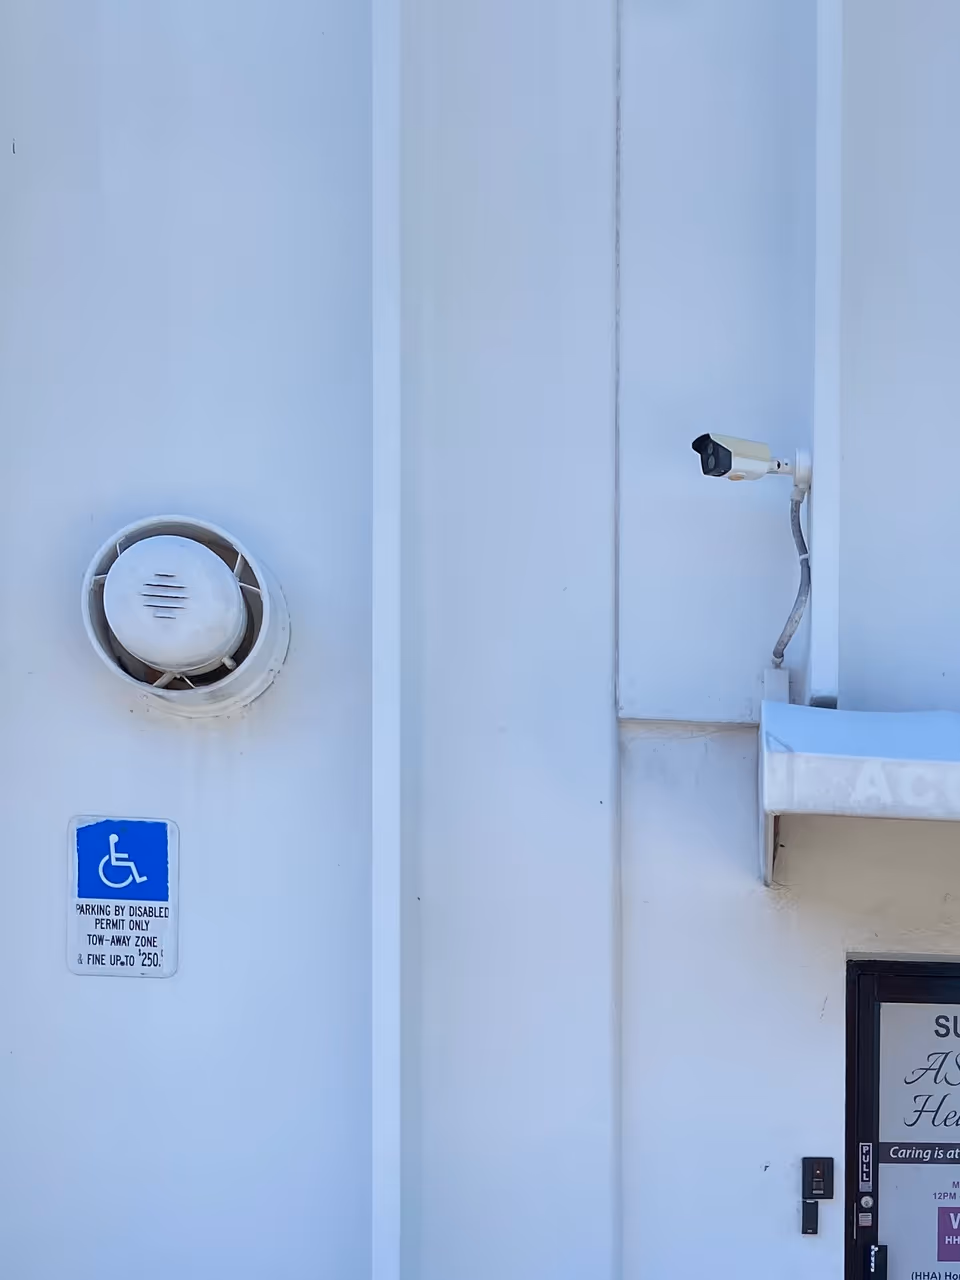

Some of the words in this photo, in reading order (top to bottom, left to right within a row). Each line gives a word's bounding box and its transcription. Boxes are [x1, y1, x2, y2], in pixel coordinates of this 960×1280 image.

[76, 903, 110, 916] PARKING
[114, 905, 125, 916] BY
[129, 906, 169, 918] DISABLED
[94, 918, 125, 930] PERMIT
[129, 919, 150, 931] ONLY
[87, 934, 131, 946] TOW-AWAY
[134, 936, 158, 947] ZONE
[87, 954, 106, 966] FINE
[110, 955, 121, 966] UP
[124, 955, 134, 966] TO
[890, 1146, 931, 1161] Caring
[934, 1148, 944, 1160] is
[946, 1149, 960, 1160] at
